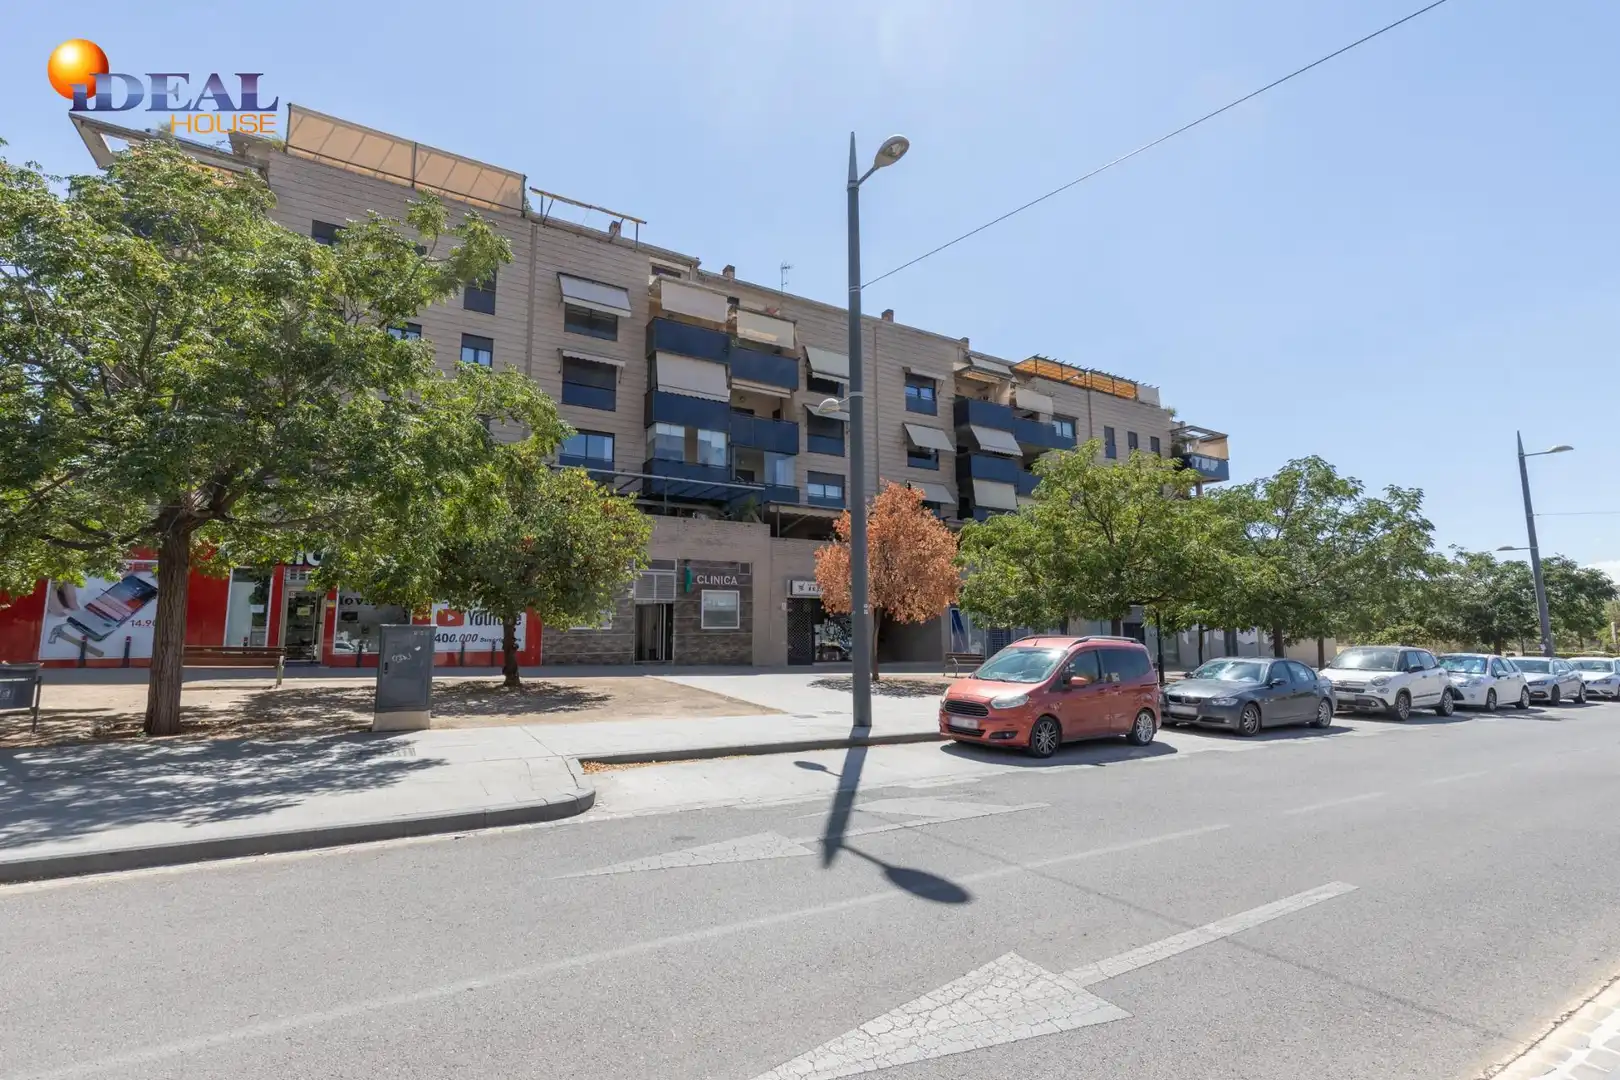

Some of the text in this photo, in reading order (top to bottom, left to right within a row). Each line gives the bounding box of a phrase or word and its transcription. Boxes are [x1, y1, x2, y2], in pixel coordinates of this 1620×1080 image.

[696, 574, 738, 585] CLINICA
[468, 609, 522, 626] Youe
[434, 633, 479, 643] 400.000
